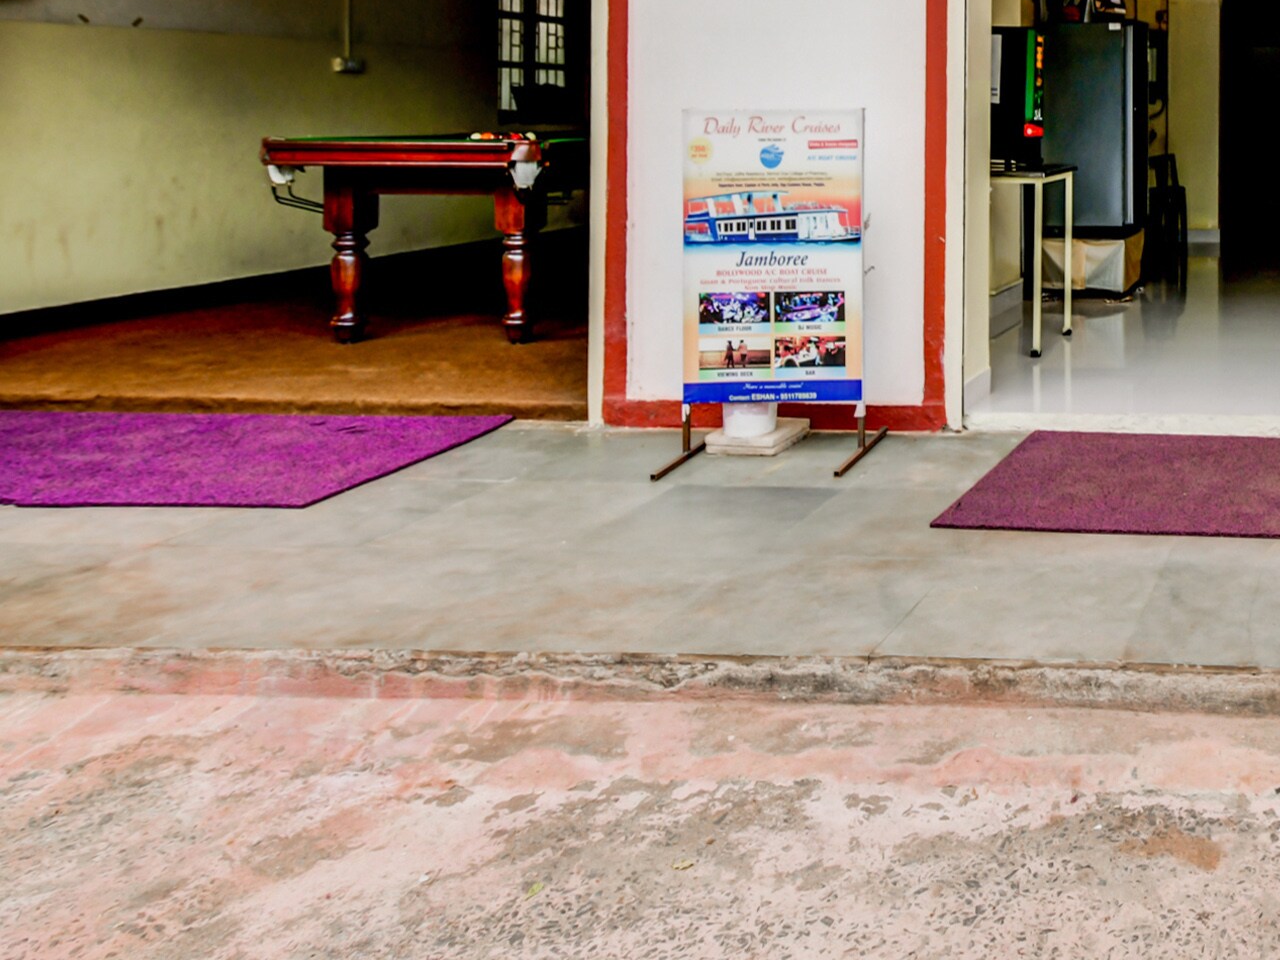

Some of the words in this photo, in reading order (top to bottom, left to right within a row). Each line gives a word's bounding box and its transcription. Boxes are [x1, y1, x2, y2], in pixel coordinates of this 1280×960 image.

[704, 117, 741, 138] Daily
[748, 116, 785, 135] River
[791, 116, 840, 134] Cruises
[736, 251, 809, 267] Jamboree
[716, 269, 762, 277] BOLLYWOOD
[779, 268, 799, 276] BOAT
[801, 267, 828, 276] CRUISE
